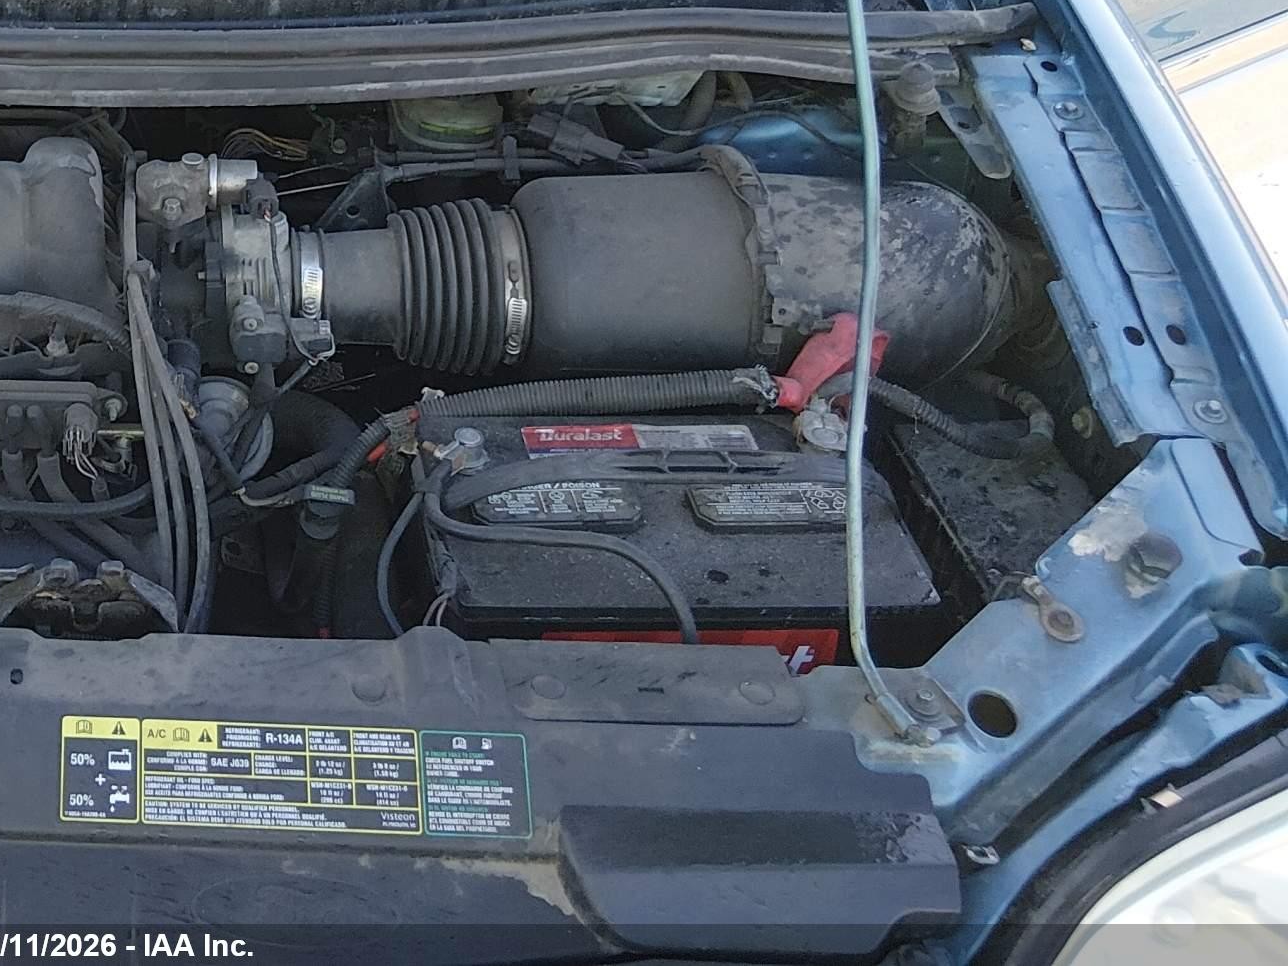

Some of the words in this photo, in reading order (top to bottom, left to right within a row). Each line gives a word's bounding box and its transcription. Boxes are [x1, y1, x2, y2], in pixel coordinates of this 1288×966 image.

[535, 427, 624, 442] Duralast
[147, 728, 166, 738] A/C
[265, 732, 303, 745] R-134A
[70, 753, 95, 766] 50%
[210, 757, 228, 767] SAE
[230, 758, 250, 768] J639
[69, 794, 94, 807] 50%
[380, 812, 416, 821] Visteon
